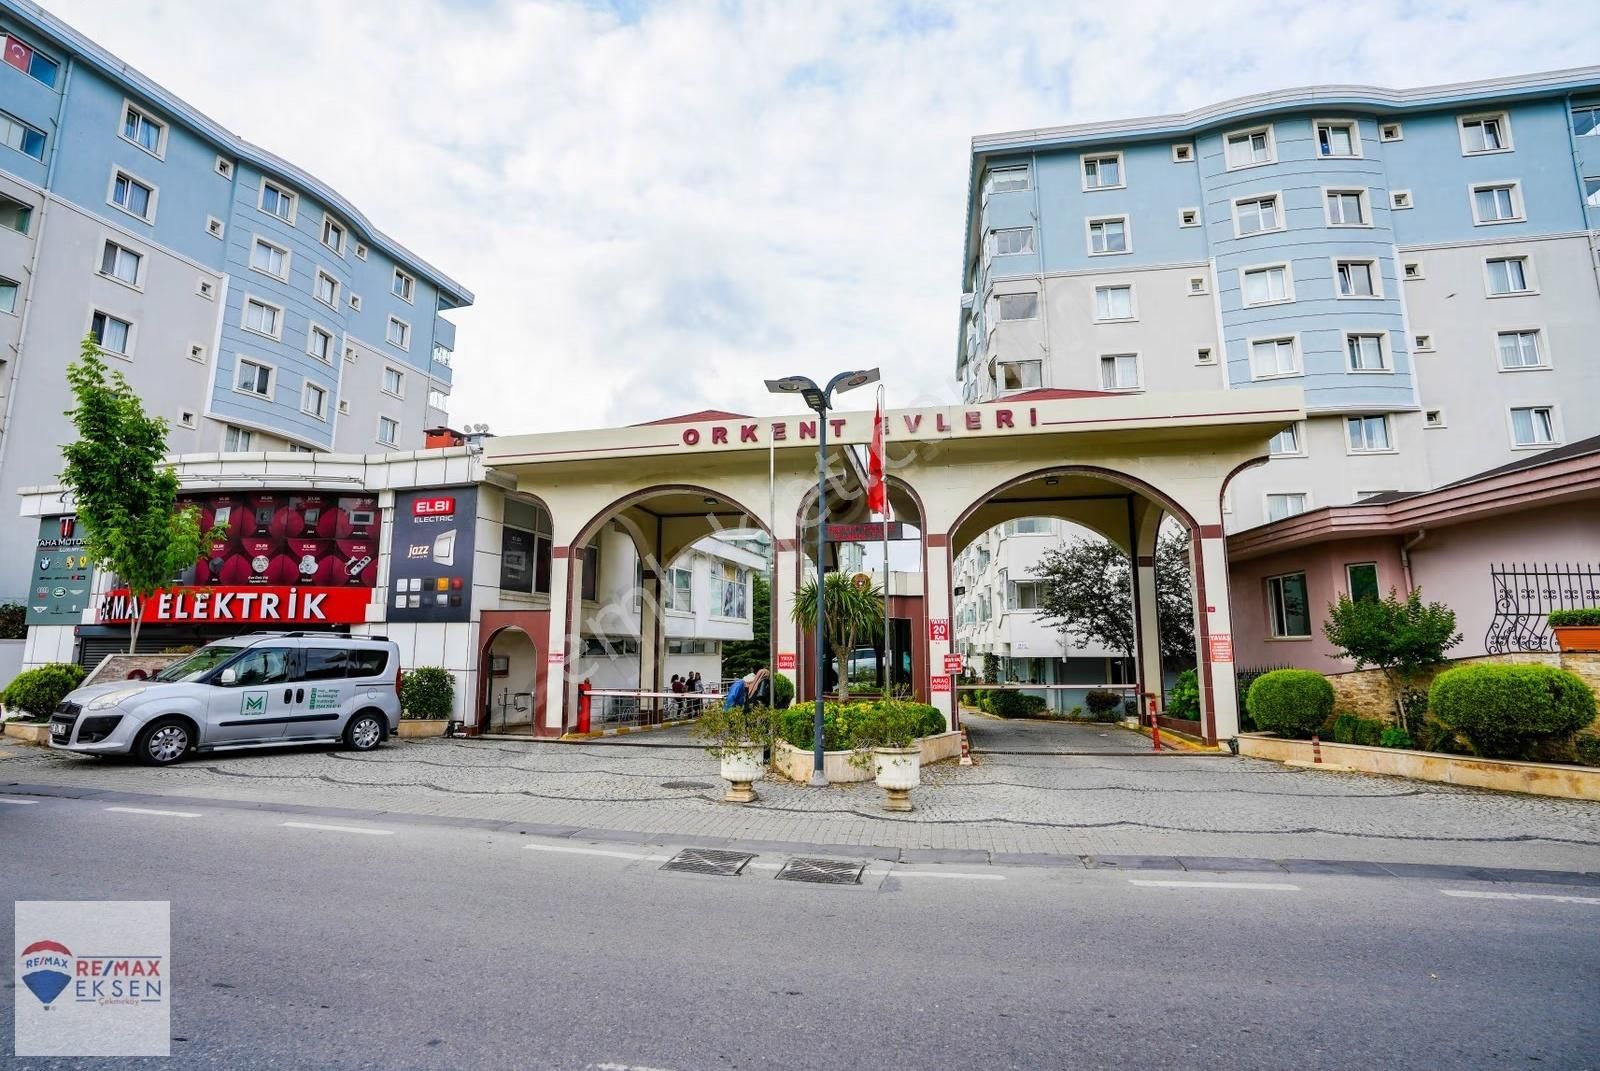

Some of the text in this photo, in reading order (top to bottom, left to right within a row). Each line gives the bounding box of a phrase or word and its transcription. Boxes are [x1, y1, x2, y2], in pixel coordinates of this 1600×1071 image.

[682, 419, 847, 446] ORKENT
[416, 500, 450, 513] ELBI
[414, 515, 454, 524] ELECTRIC
[408, 544, 430, 559] jazz
[157, 587, 328, 620] ELEKTRİK
[933, 625, 945, 634] 20
